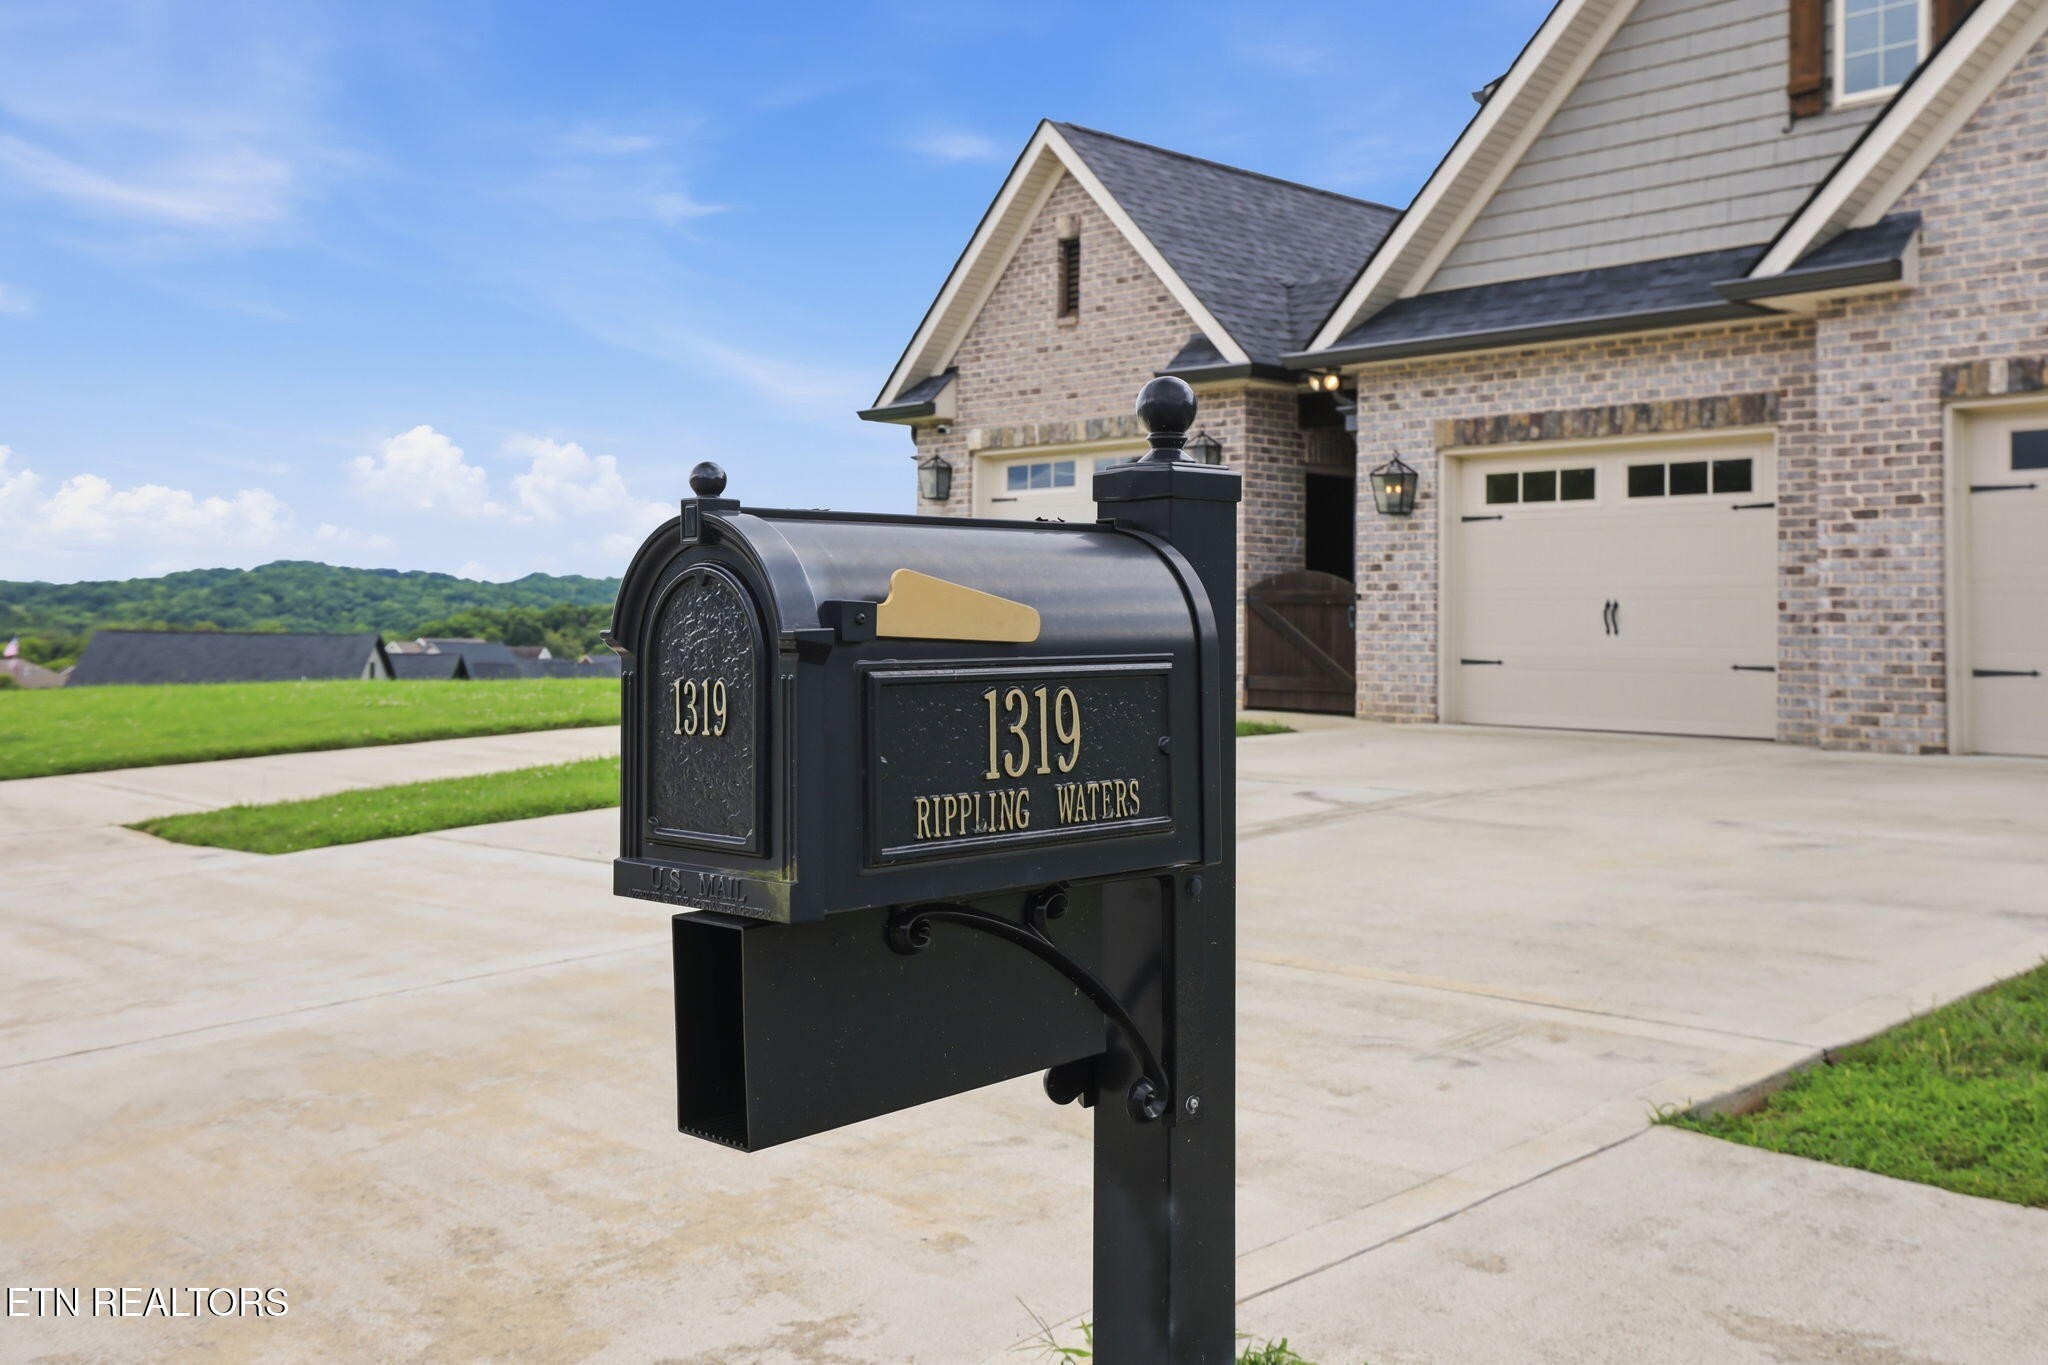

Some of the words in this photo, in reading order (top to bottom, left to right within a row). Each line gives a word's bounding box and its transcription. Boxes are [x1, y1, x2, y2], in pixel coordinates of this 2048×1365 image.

[674, 679, 726, 736] 1319
[983, 685, 1081, 780] 1319
[915, 789, 1030, 839] RIPPLING
[1056, 779, 1141, 824] WATERS
[651, 866, 687, 894] U.S.
[697, 871, 748, 902] MAIL
